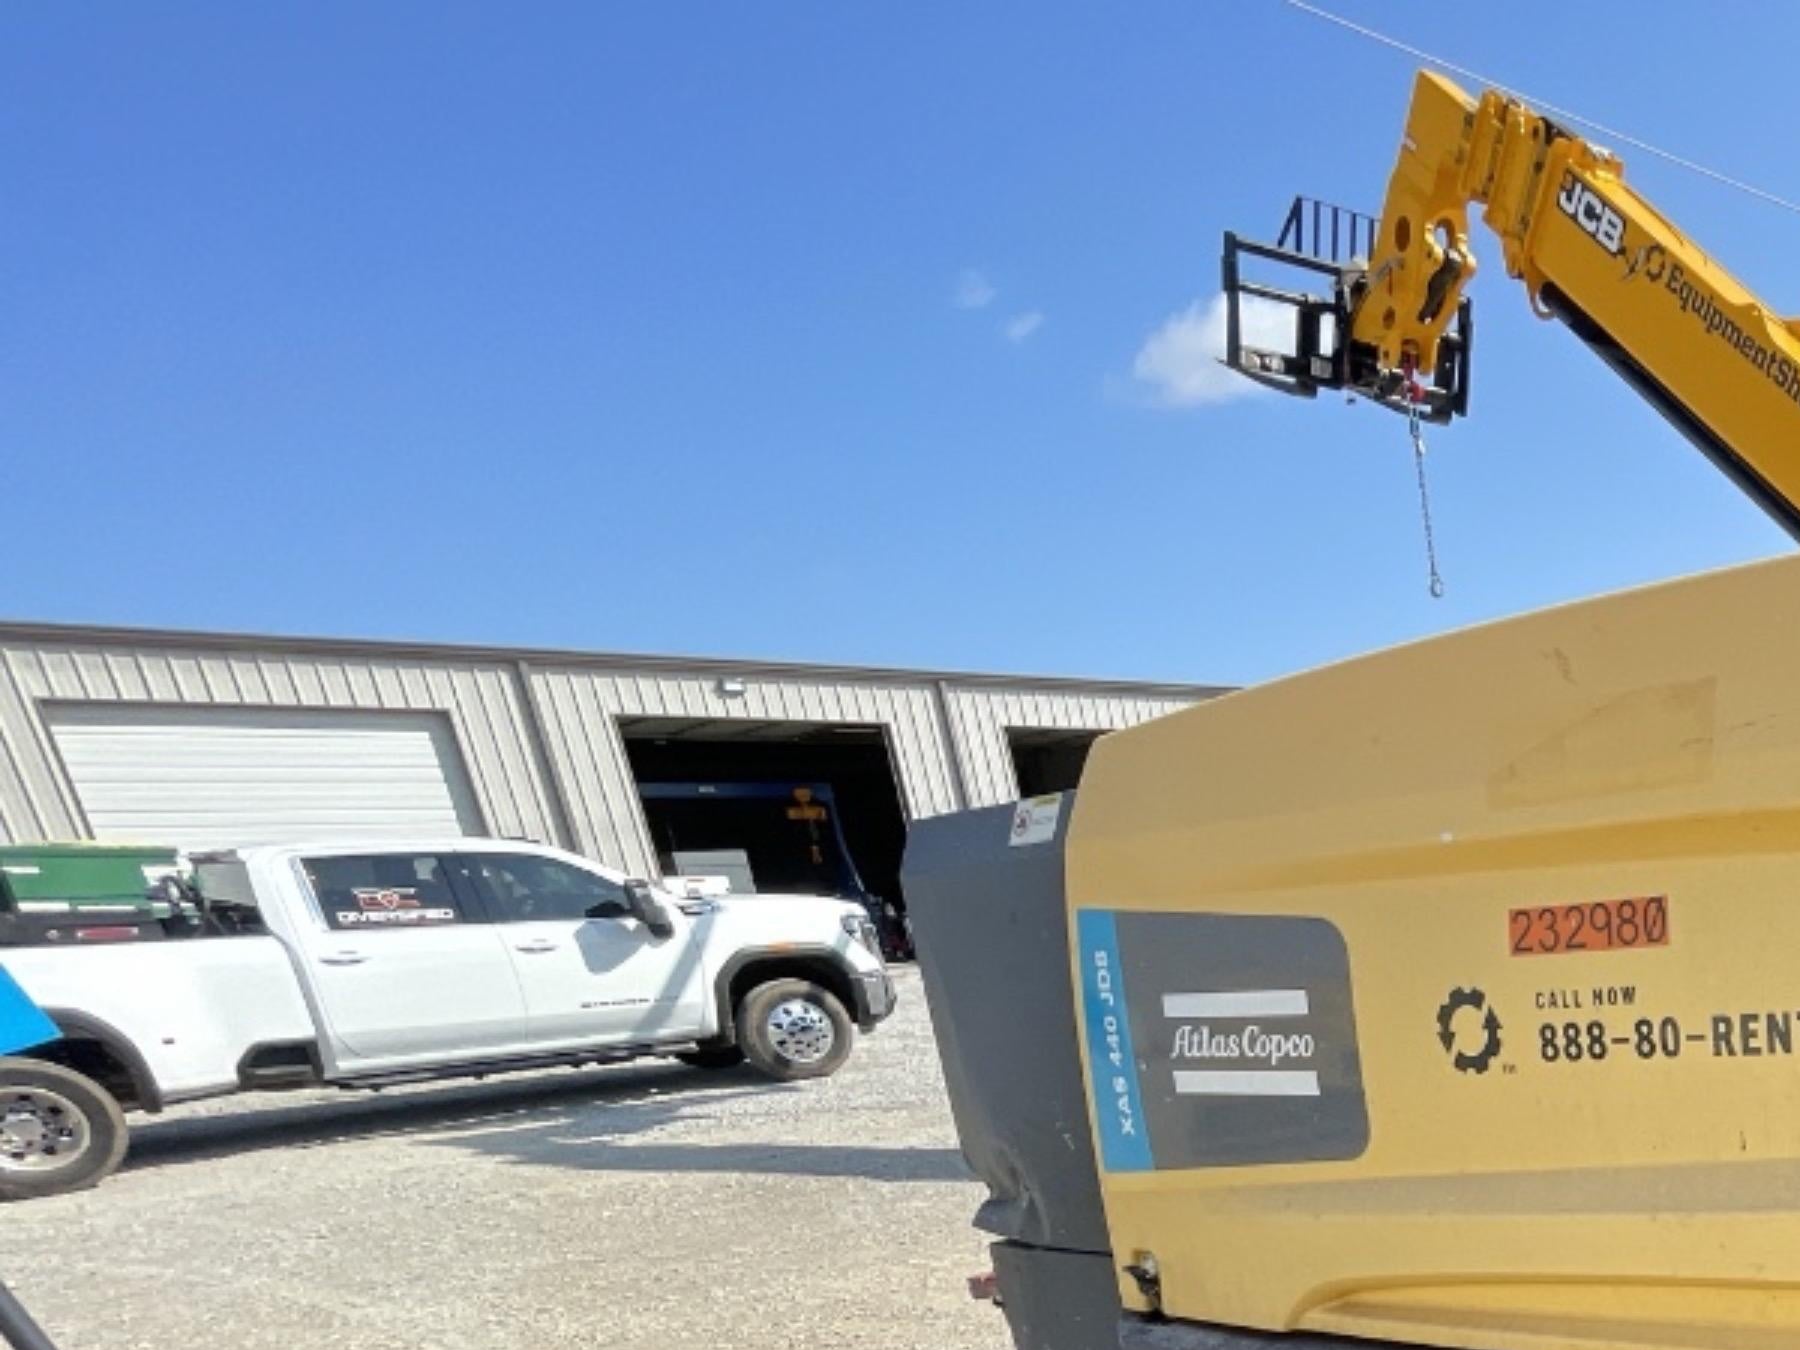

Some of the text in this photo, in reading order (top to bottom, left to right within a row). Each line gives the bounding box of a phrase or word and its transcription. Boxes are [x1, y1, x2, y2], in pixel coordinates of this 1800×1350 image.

[1557, 180, 1626, 254] JCB
[1511, 896, 1668, 953] 232980
[1535, 986, 1637, 1010] CALL NOW
[1103, 1016, 1124, 1069] 440
[1111, 1076, 1135, 1136] XAS
